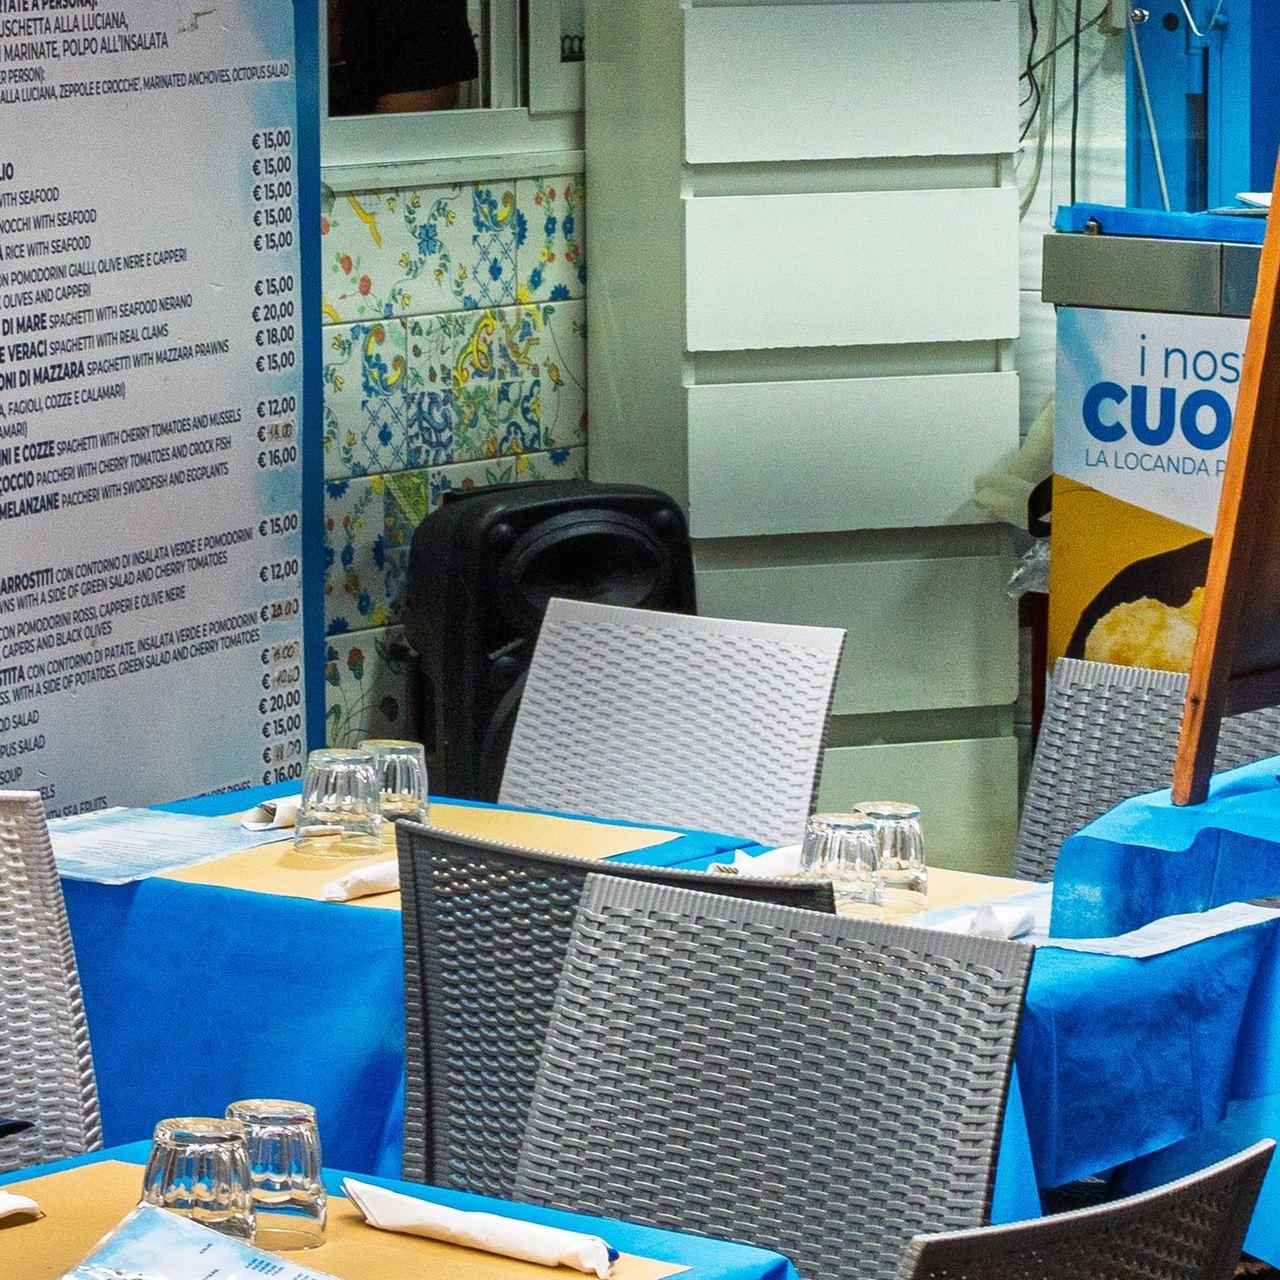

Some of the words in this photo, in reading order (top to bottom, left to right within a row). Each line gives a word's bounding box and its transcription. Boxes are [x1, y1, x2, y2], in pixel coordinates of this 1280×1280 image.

[53, 15, 79, 34] ALLA
[81, 11, 130, 32] LUCIANA,
[3, 40, 59, 62] MARINATE,
[62, 37, 98, 57] POLPO
[0, 89, 19, 104] ALLA
[21, 85, 58, 102] LUCIANA,
[59, 82, 93, 98] ZEPPOLE
[263, 130, 291, 151] 15,00
[18, 186, 60, 206] SEAFOOD
[57, 208, 97, 228] SEAFOOD
[5, 243, 24, 261] RICE
[51, 235, 91, 255] SEAFOOD
[10, 263, 66, 286] POMODORINI
[153, 247, 187, 266] CAPPERI
[55, 283, 91, 302] CAPPERI
[263, 301, 294, 321] 20,00
[1, 319, 13, 337] DI
[16, 314, 46, 334] MARE
[266, 325, 294, 347] 18,00
[8, 341, 47, 362] VERACI
[119, 328, 139, 345] REAL
[141, 323, 169, 341] CLAMS
[1139, 334, 1147, 376] i
[1164, 347, 1247, 382] nos
[18, 369, 30, 387] DI
[33, 361, 84, 385] MAZZARA
[267, 396, 295, 418] 12,00
[22, 440, 54, 462] COZZE
[269, 446, 297, 467] 16,00
[1085, 449, 1109, 468] LA
[1114, 451, 1210, 477] LOCANDA
[0, 568, 53, 596] ARROSTITI
[17, 592, 38, 611] WITH
[47, 586, 65, 604] SIDE
[17, 609, 71, 637] POMODORINI
[2, 638, 34, 660] CAPERS
[55, 627, 82, 648] BLACK
[47, 649, 92, 675] CONTORNO
[270, 689, 301, 712] 20,00
[12, 709, 39, 730] SALAD
[18, 734, 45, 755] SALAD
[0, 767, 23, 785] SOUP
